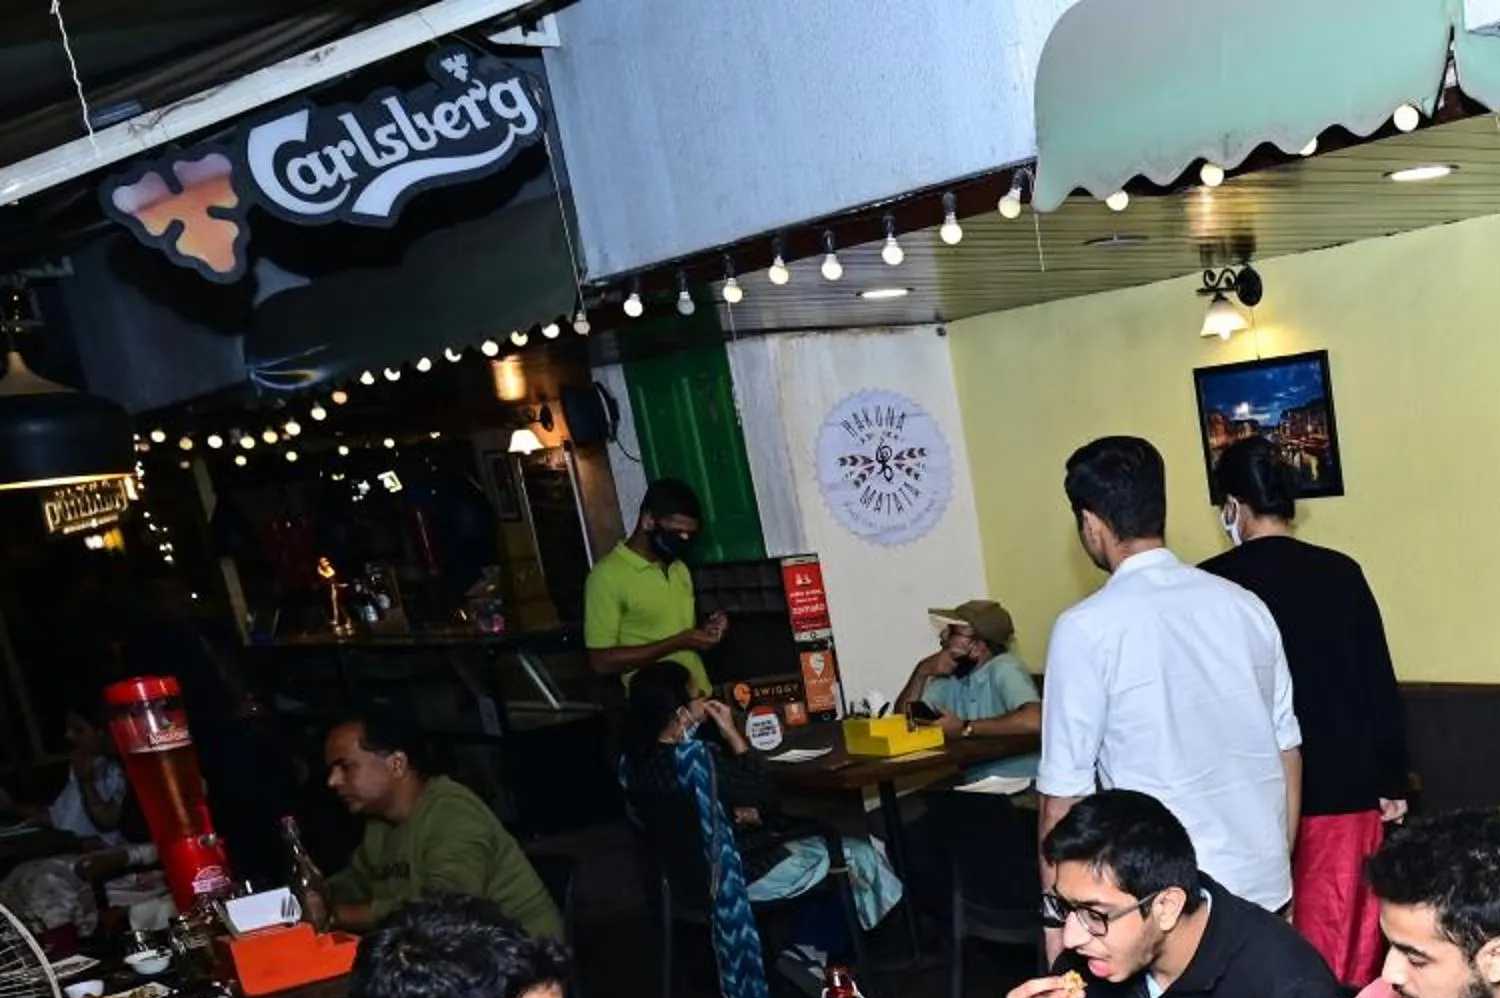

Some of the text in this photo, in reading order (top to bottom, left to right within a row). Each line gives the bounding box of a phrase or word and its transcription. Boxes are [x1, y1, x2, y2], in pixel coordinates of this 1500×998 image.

[248, 73, 538, 216] Carlsberg
[841, 405, 906, 438] HAKUNA
[859, 482, 922, 516] MATATA
[753, 684, 799, 698] SWIGGY
